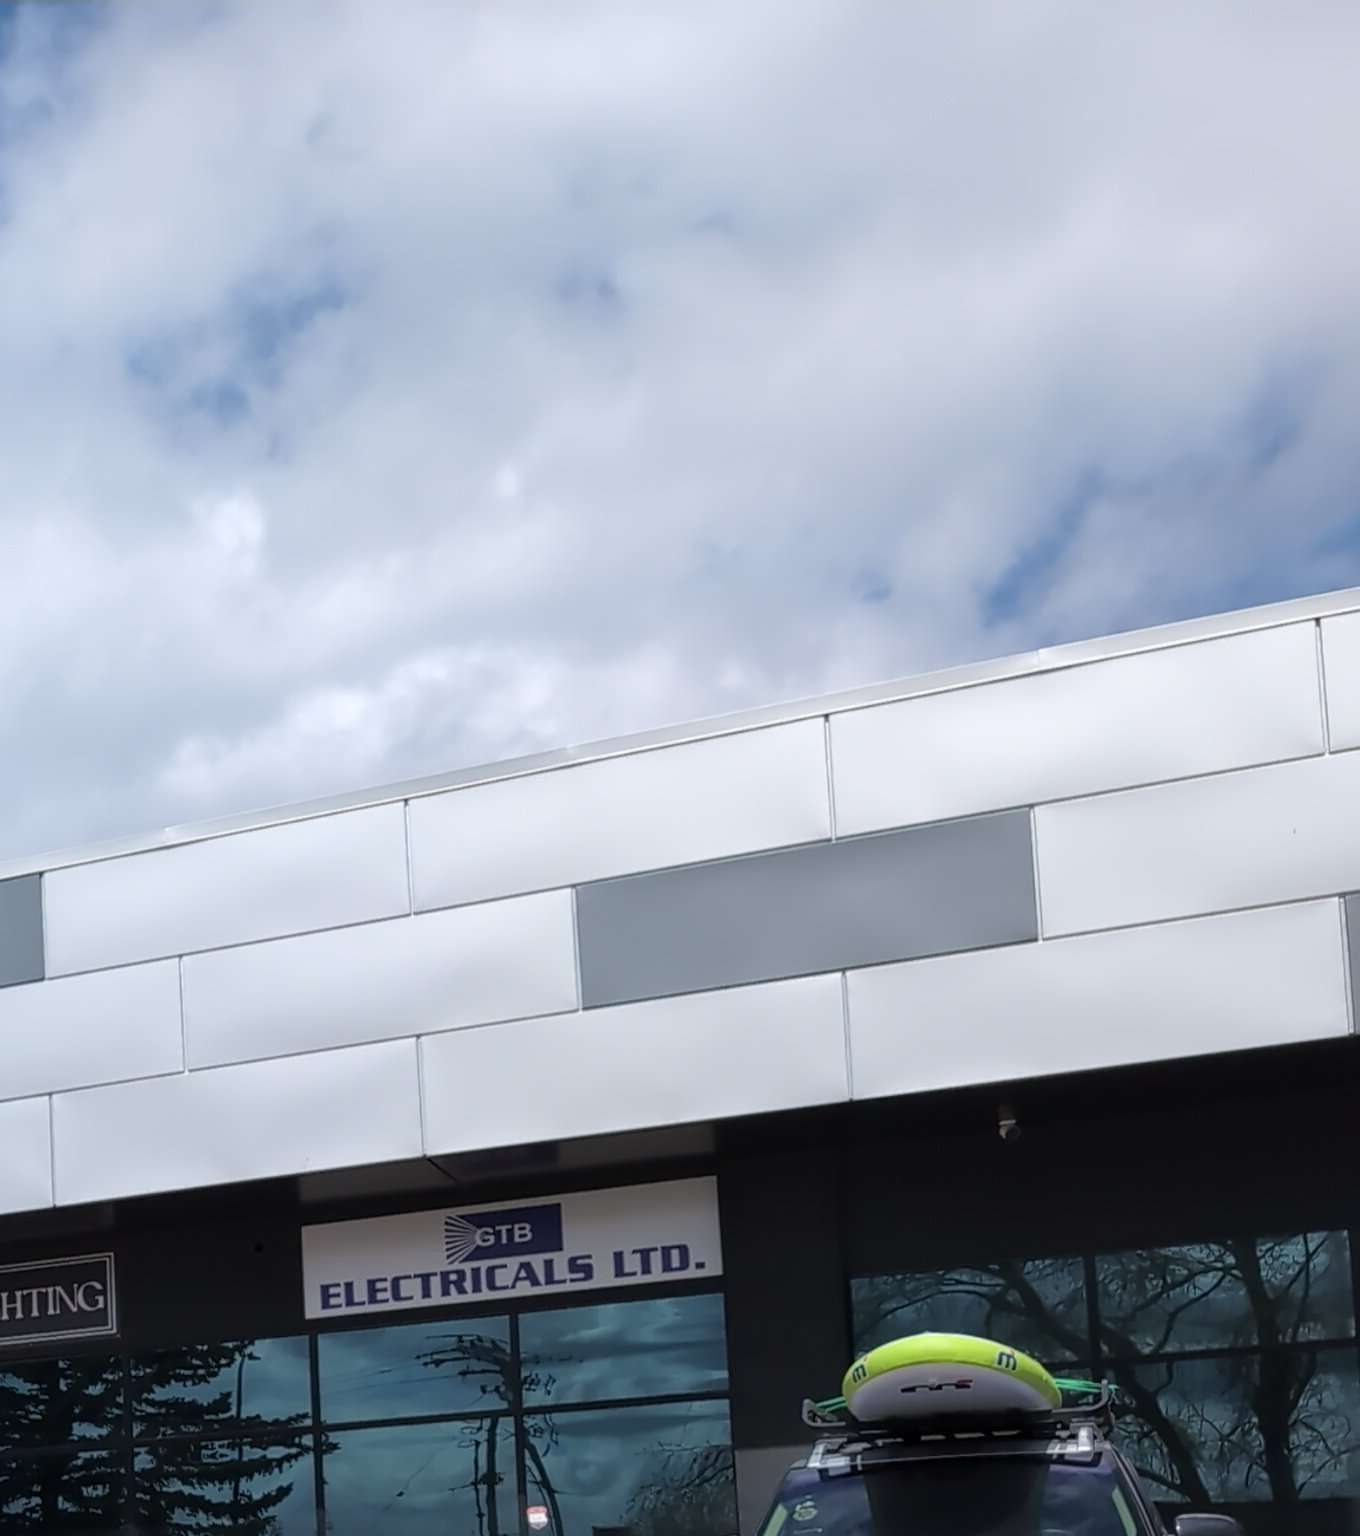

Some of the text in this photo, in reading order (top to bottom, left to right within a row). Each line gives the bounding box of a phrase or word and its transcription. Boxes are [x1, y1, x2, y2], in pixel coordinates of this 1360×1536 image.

[477, 1222, 534, 1248] GTB
[319, 1243, 707, 1311] ELECTRICALS LTD.
